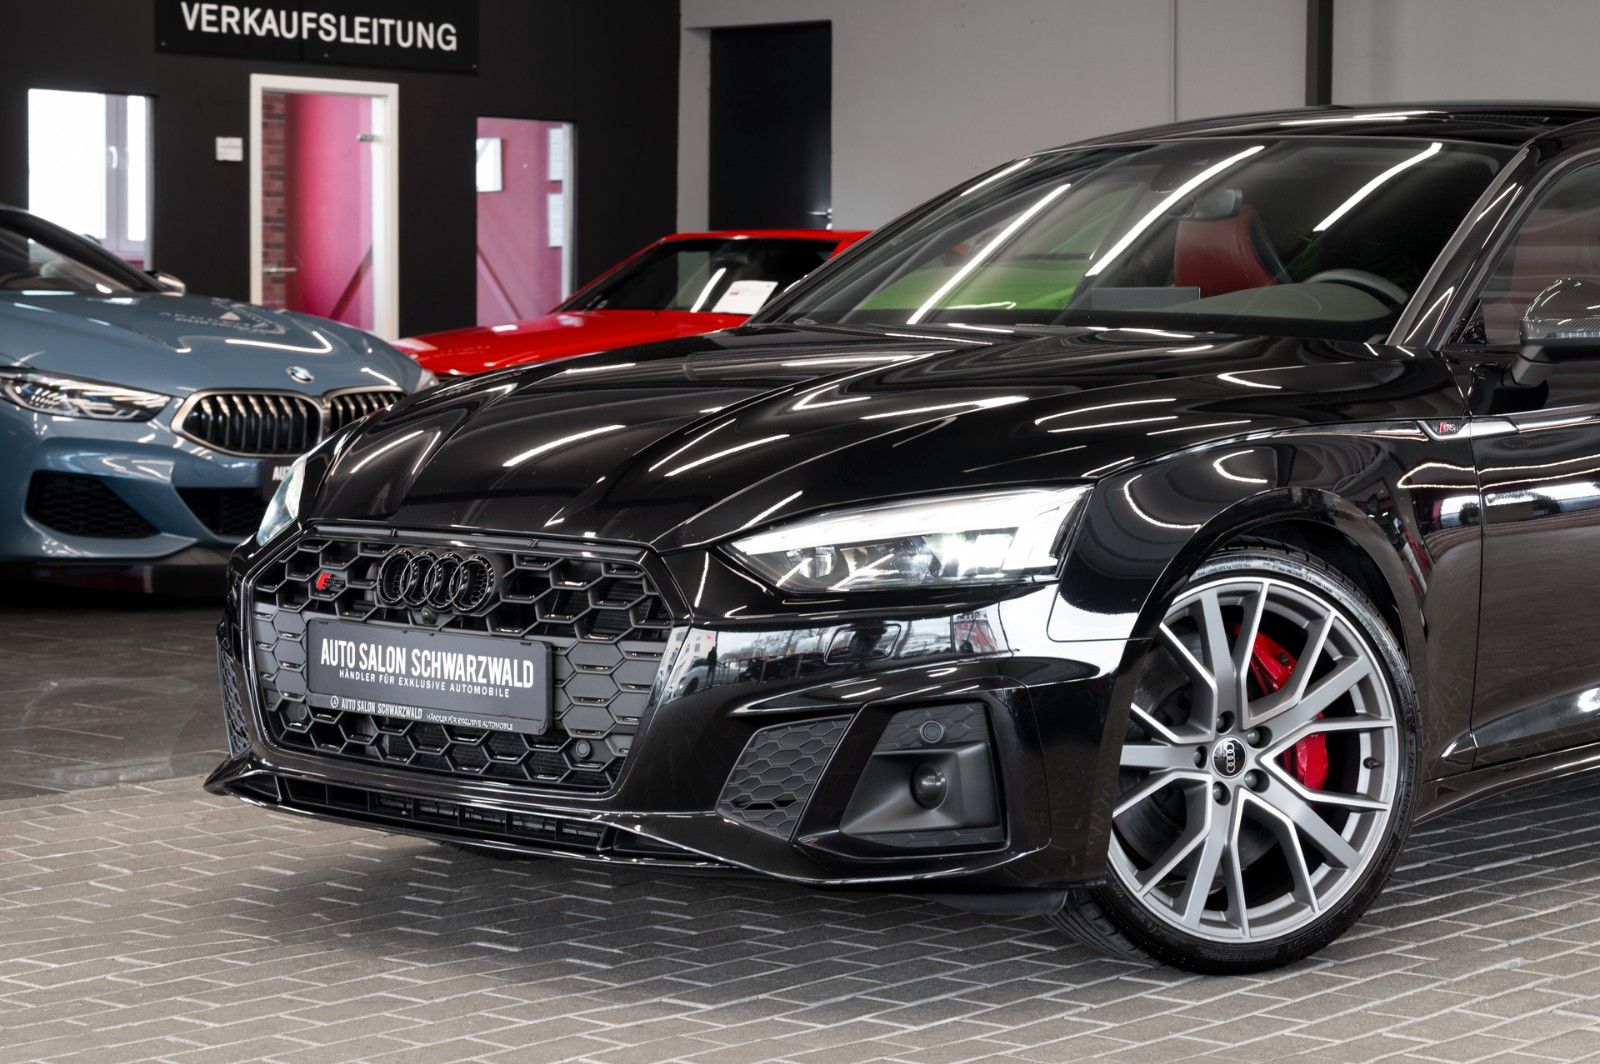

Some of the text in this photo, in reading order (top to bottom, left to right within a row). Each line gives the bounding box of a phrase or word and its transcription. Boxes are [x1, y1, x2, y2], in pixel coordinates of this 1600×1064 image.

[181, 1, 457, 51] VERKAUFSLEITUNG
[320, 638, 534, 689] AUTO SALON SCHWARZWALD
[339, 668, 510, 698] HÄNDLER FÜR EXKLUSIVE AUTOMOBILE
[341, 698, 356, 711] AUTO
[357, 700, 376, 713] SALON
[377, 703, 423, 719] SCHWARZWALD
